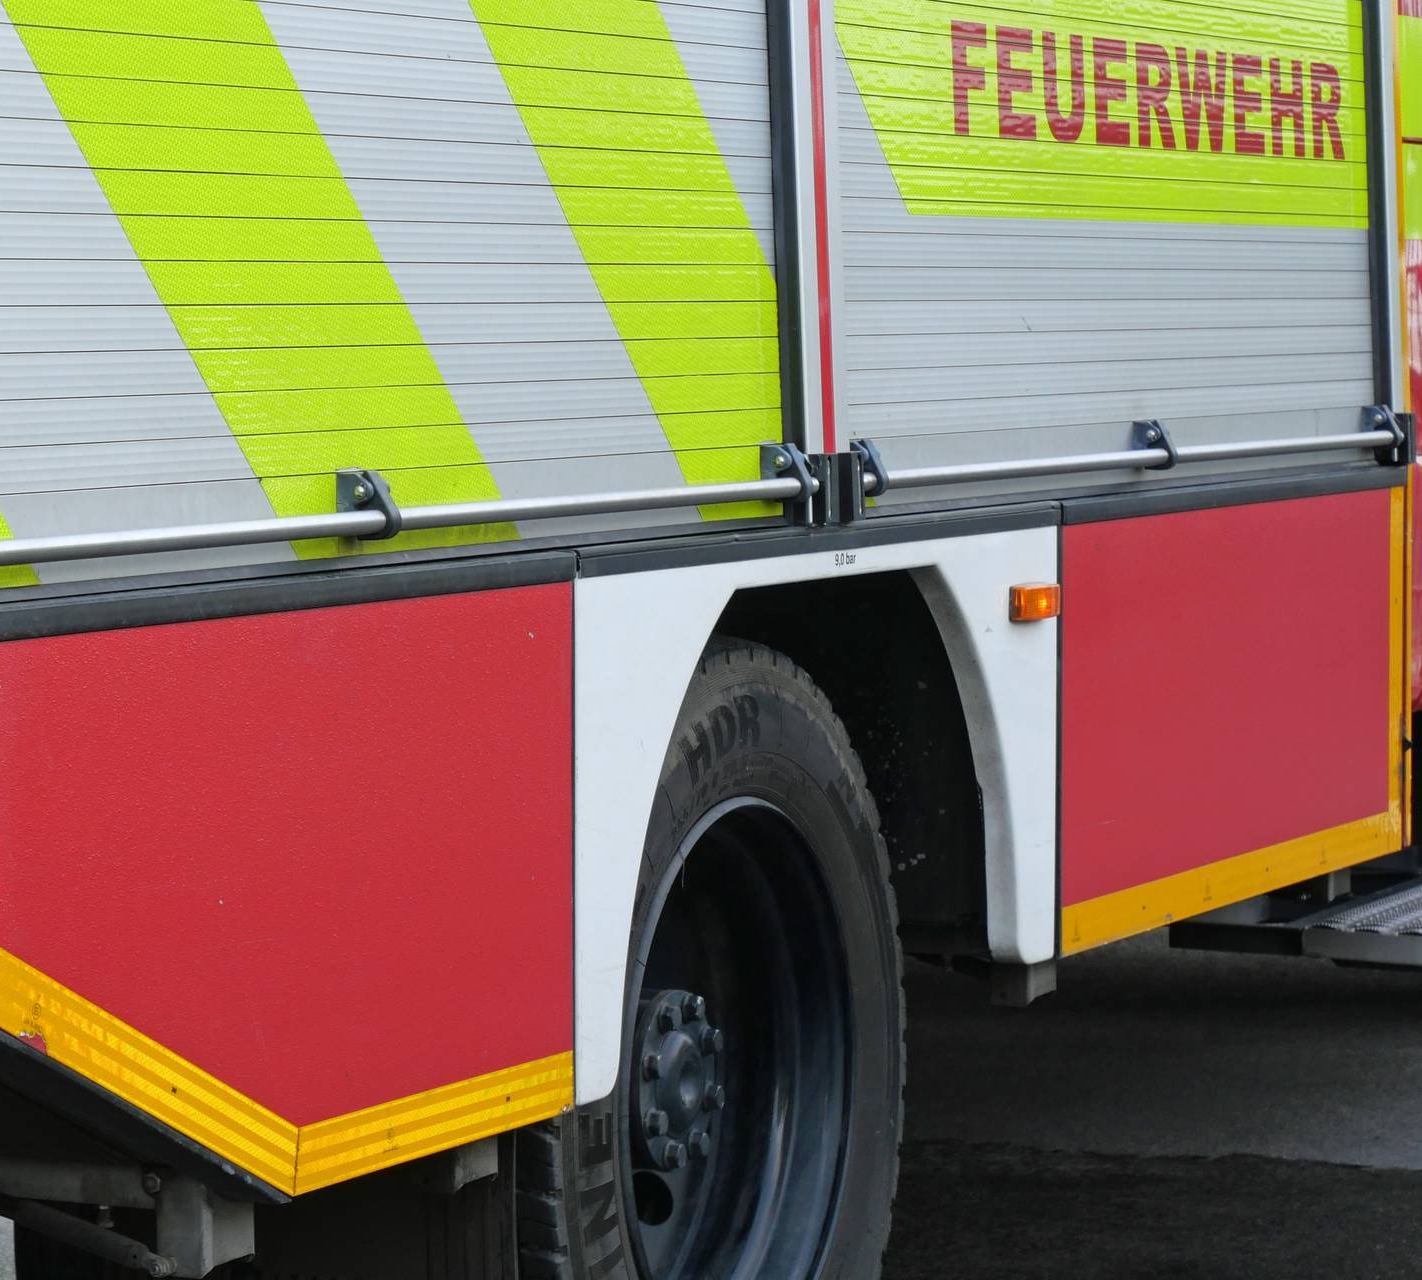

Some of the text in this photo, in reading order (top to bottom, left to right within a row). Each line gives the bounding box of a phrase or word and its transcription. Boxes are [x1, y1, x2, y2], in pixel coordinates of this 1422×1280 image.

[949, 19, 1346, 161] FEUERWEHR
[846, 552, 856, 565] bar
[677, 694, 762, 787] HDR
